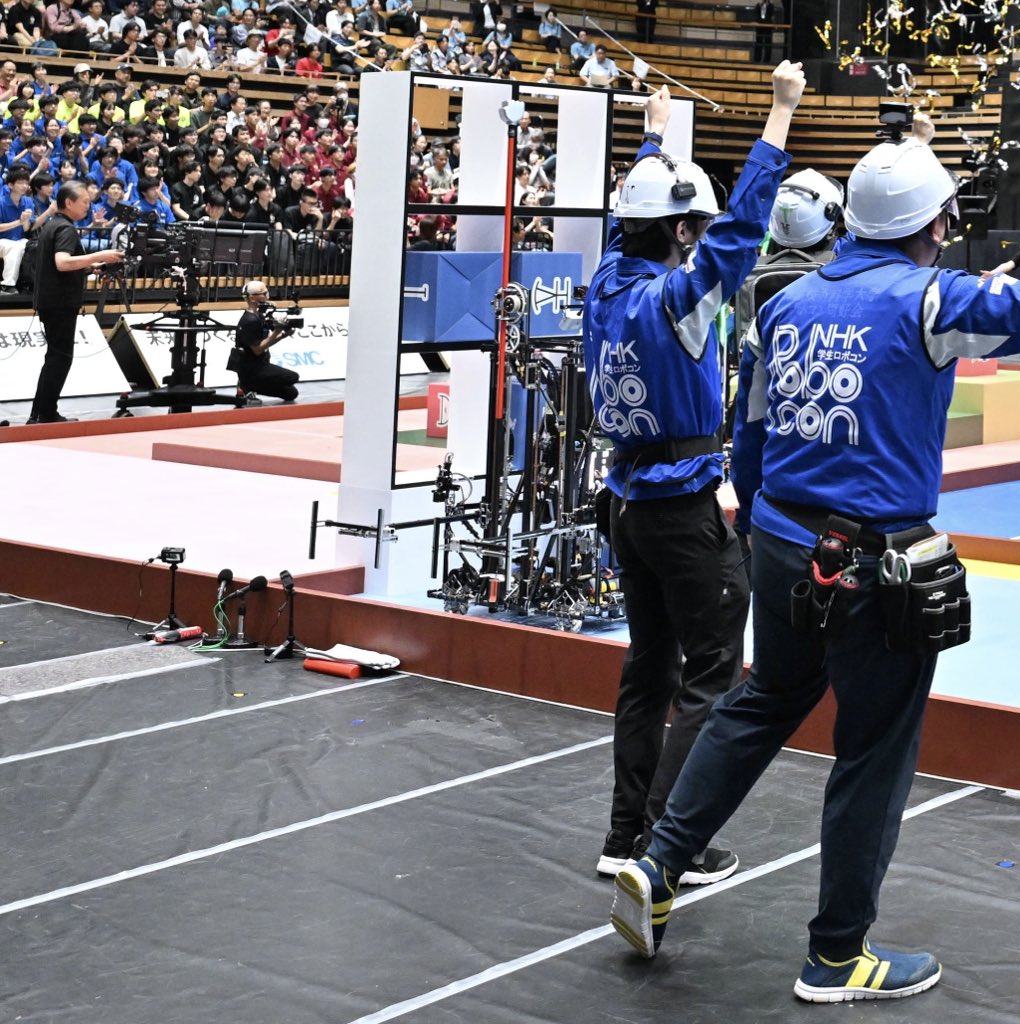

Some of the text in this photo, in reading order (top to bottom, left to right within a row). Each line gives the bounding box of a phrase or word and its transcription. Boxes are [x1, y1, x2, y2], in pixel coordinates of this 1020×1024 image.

[813, 324, 872, 352] NHK
[283, 351, 325, 367] SMC
[607, 340, 640, 364] HK
[817, 349, 867, 364] 学生ロボコン
